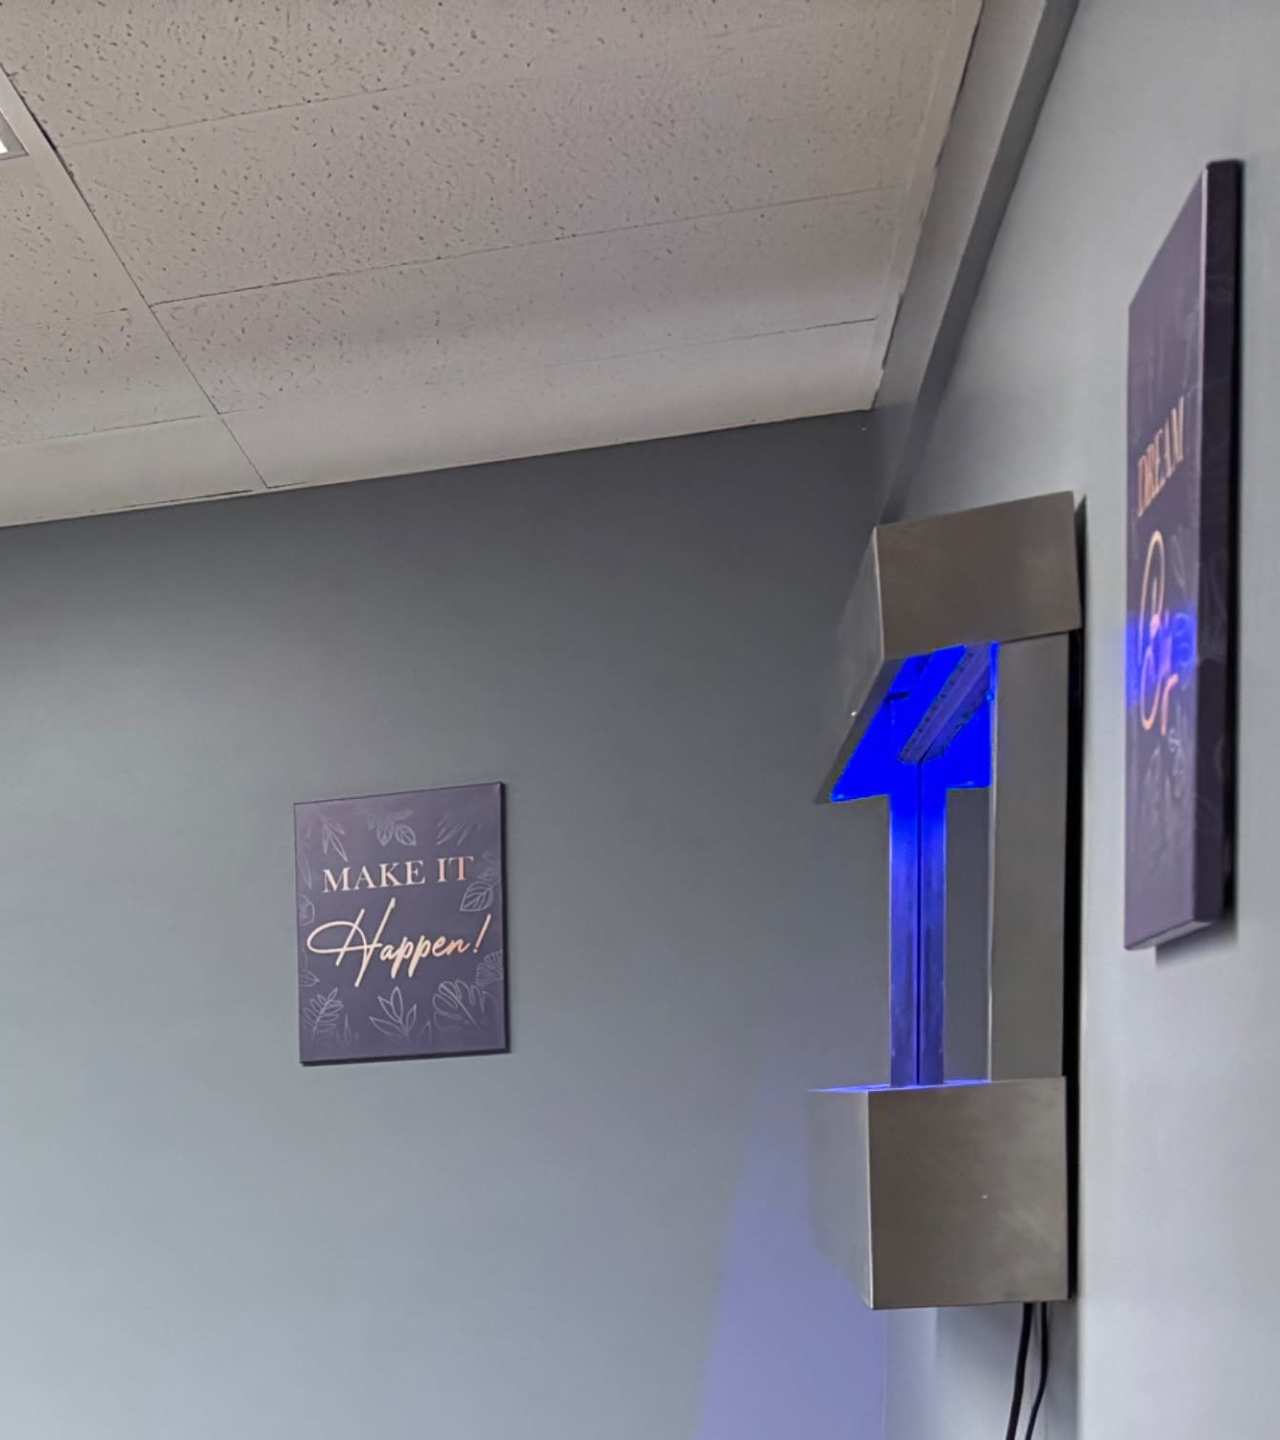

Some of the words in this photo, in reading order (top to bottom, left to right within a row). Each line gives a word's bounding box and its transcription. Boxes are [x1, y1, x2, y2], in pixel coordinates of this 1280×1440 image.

[1137, 396, 1185, 518] DREAM
[323, 859, 426, 894] MAKE
[437, 855, 474, 883] IT
[306, 896, 492, 988] Happen!
